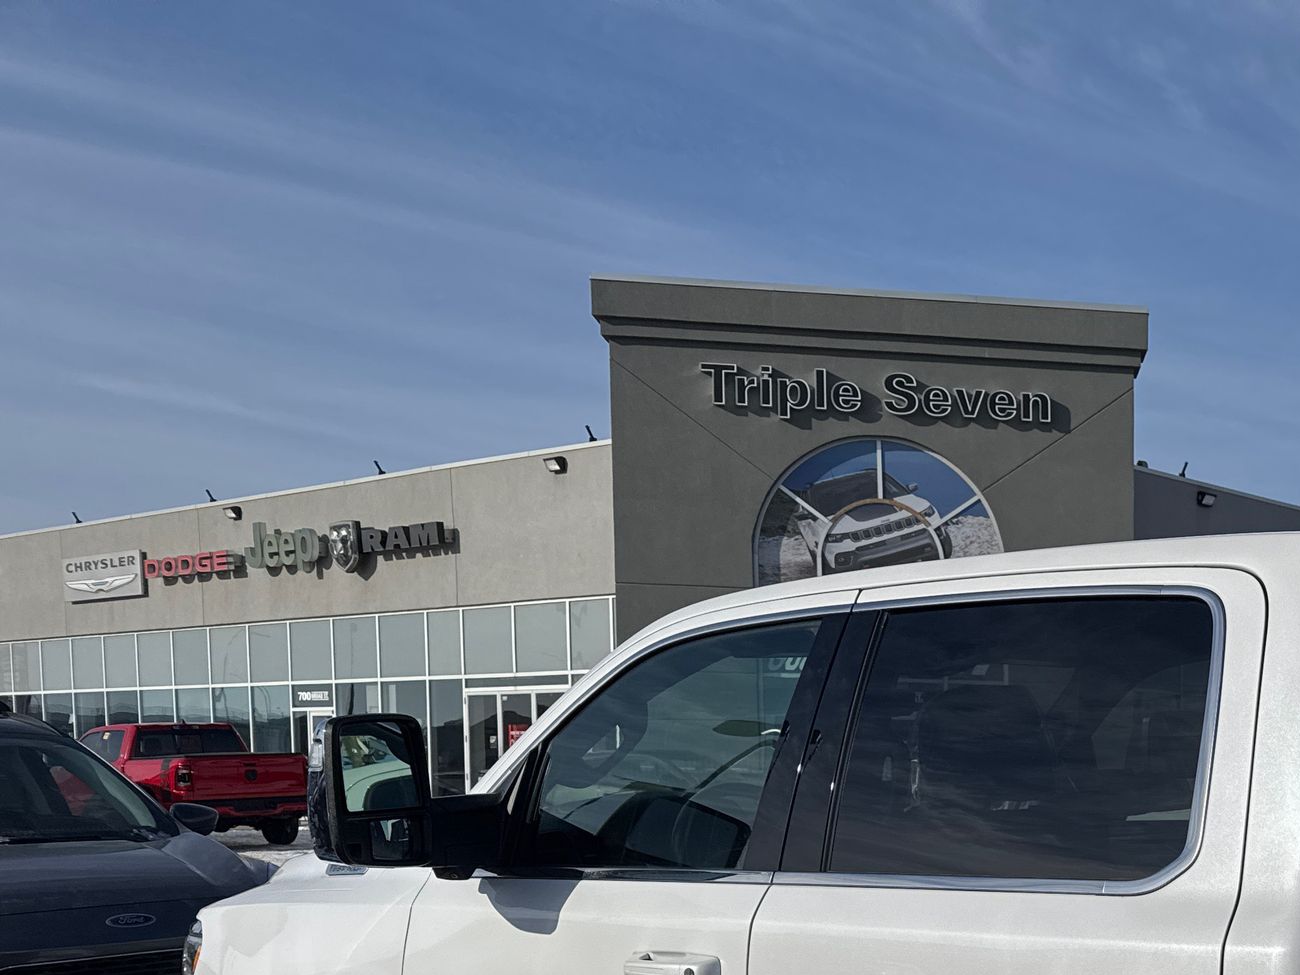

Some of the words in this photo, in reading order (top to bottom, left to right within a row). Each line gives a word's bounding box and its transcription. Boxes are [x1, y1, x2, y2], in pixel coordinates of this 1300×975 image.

[700, 363, 863, 419] Triple
[882, 372, 1052, 423] Seven
[245, 522, 319, 572] Jeep
[361, 521, 444, 553] RAM
[65, 555, 136, 574] CHRYSLER
[144, 550, 230, 579] DODGE
[297, 691, 311, 701] 700
